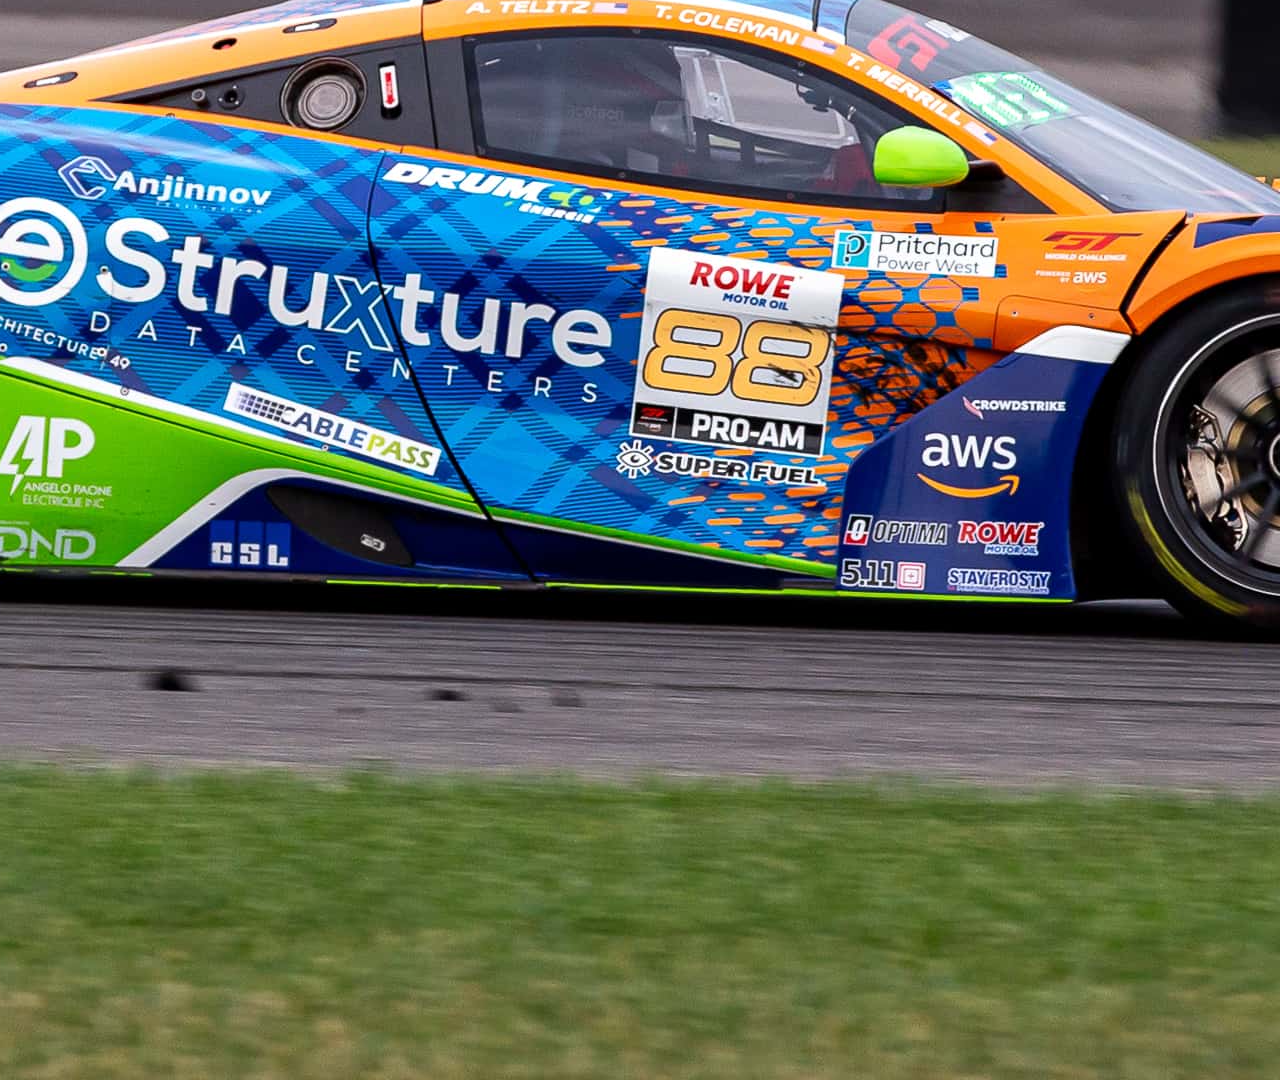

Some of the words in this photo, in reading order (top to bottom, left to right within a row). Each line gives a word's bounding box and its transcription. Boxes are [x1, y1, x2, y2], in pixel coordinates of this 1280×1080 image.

[465, 1, 491, 14] A.
[499, 0, 591, 14] TELITZ
[655, 5, 672, 19] T.
[678, 7, 798, 46] COLEMAN
[847, 54, 862, 71] T.
[865, 65, 964, 126] MERRILL
[113, 170, 271, 205] Anjinnov
[878, 234, 995, 258] Pritchard
[876, 255, 929, 272] Power
[935, 259, 979, 274] West
[1073, 271, 1107, 284] aws
[96, 217, 612, 368] Struxture
[689, 260, 795, 299] ROWE
[722, 293, 767, 308] MOTOR
[769, 299, 789, 311] OIL
[89, 311, 247, 355] DATA
[296, 344, 598, 404] CENTERS
[642, 307, 831, 407] 88
[971, 399, 1067, 412] CROWDSTRIKE
[690, 413, 806, 450] PRO-AM
[922, 432, 1017, 470] aws
[658, 453, 747, 479] SUPER
[753, 463, 820, 485] FUEL
[873, 520, 948, 545] OPTIMA
[958, 521, 1040, 545] ROWE
[210, 541, 289, 567] CSL
[985, 544, 1020, 555] MOTOR
[1021, 546, 1039, 556] OIL
[841, 558, 896, 588] 5.11
[949, 569, 986, 585] STAY
[989, 571, 1050, 588] FROSTY
